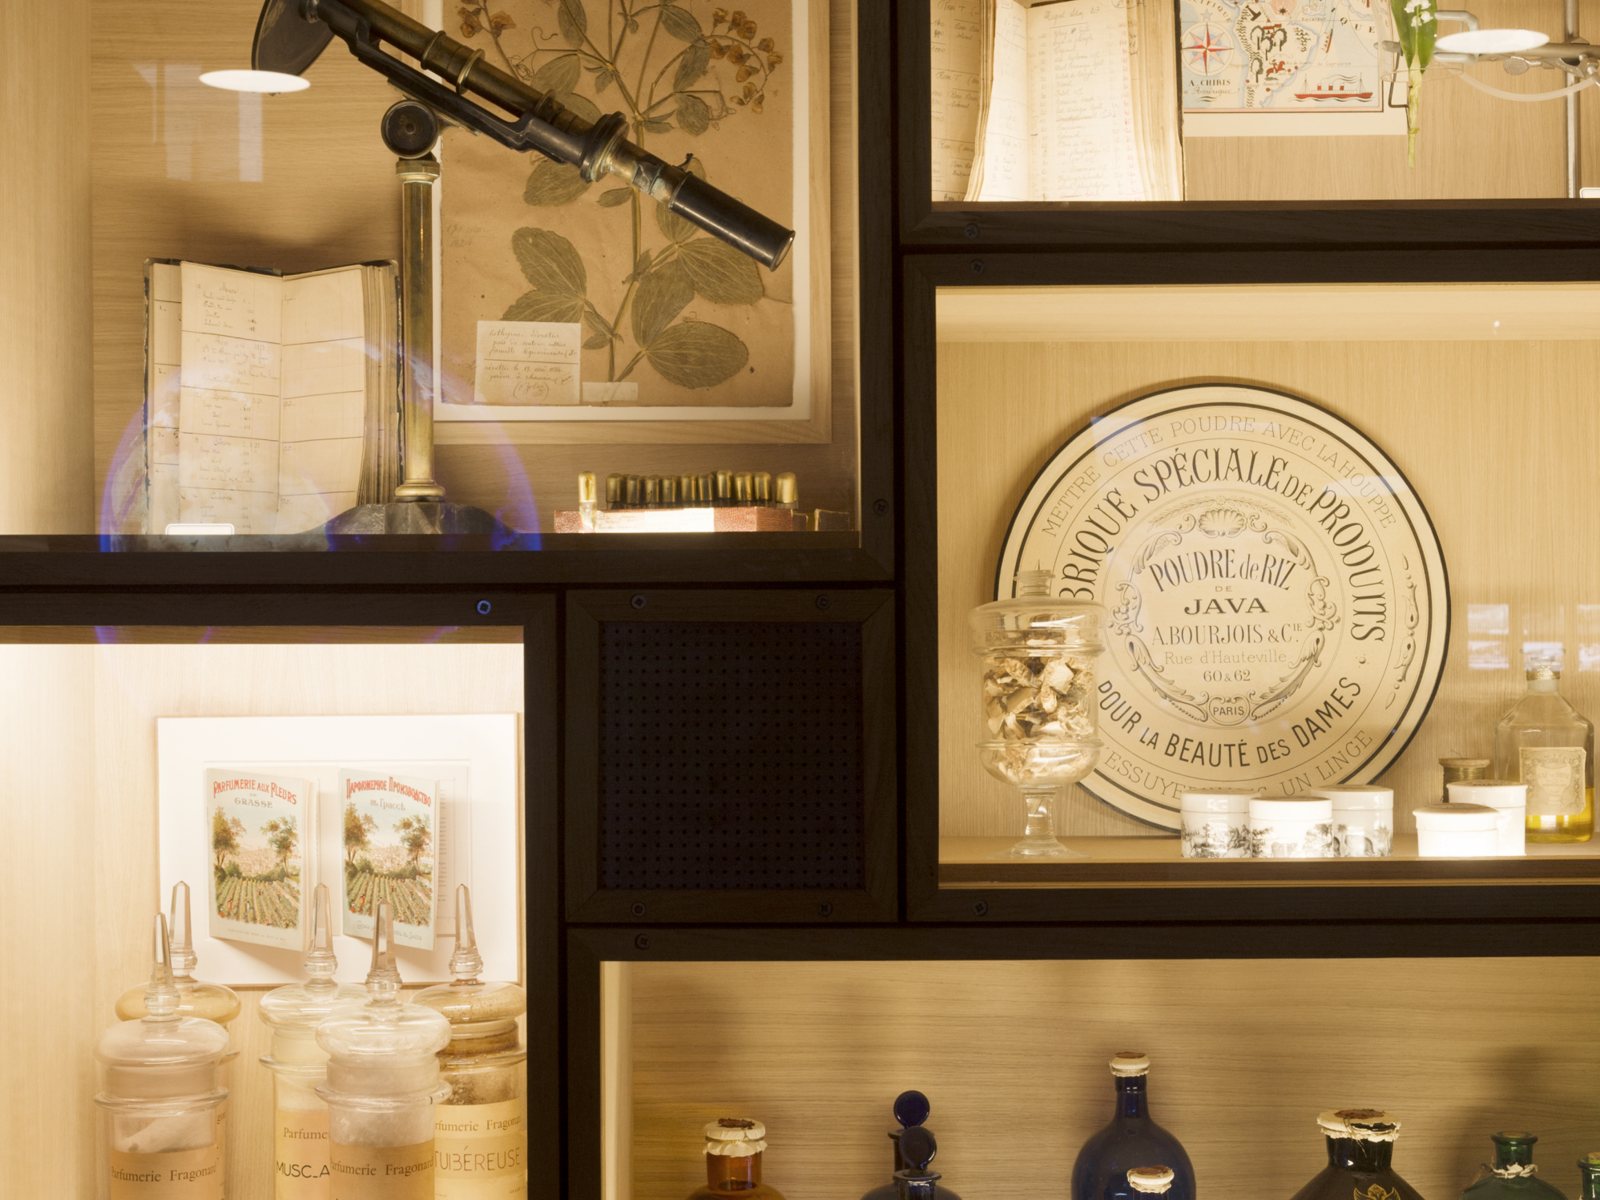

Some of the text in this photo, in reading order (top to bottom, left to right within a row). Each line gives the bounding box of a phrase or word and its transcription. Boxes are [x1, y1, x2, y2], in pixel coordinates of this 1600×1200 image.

[1041, 465, 1101, 537] METTRE
[1103, 427, 1163, 468] CETTE
[1170, 415, 1256, 437] POUDRE
[1263, 421, 1316, 451] AVEC
[1338, 459, 1397, 529] HOUPPE
[1059, 447, 1387, 642] BRIQUE SPÉCIALE DE PRODUITS
[1149, 549, 1297, 592] POUDRE de RIZ
[1184, 597, 1269, 615] JAVA
[1268, 628, 1279, 644] &
[1164, 650, 1287, 665] Rue d'Hauteville
[1203, 670, 1250, 682] 60 & 62
[1213, 706, 1245, 716] PARIS
[1098, 676, 1361, 768] POUR LA BEAUTÉ DES DAMES
[1280, 773, 1312, 797] UN
[1316, 730, 1373, 781] LINGE
[213, 779, 256, 799] PARFUMERIE
[234, 797, 273, 808] GRASSE
[283, 1127, 328, 1140] Parfume
[434, 1119, 479, 1132] rfumerie
[434, 1145, 521, 1172] TUBÉREUSE
